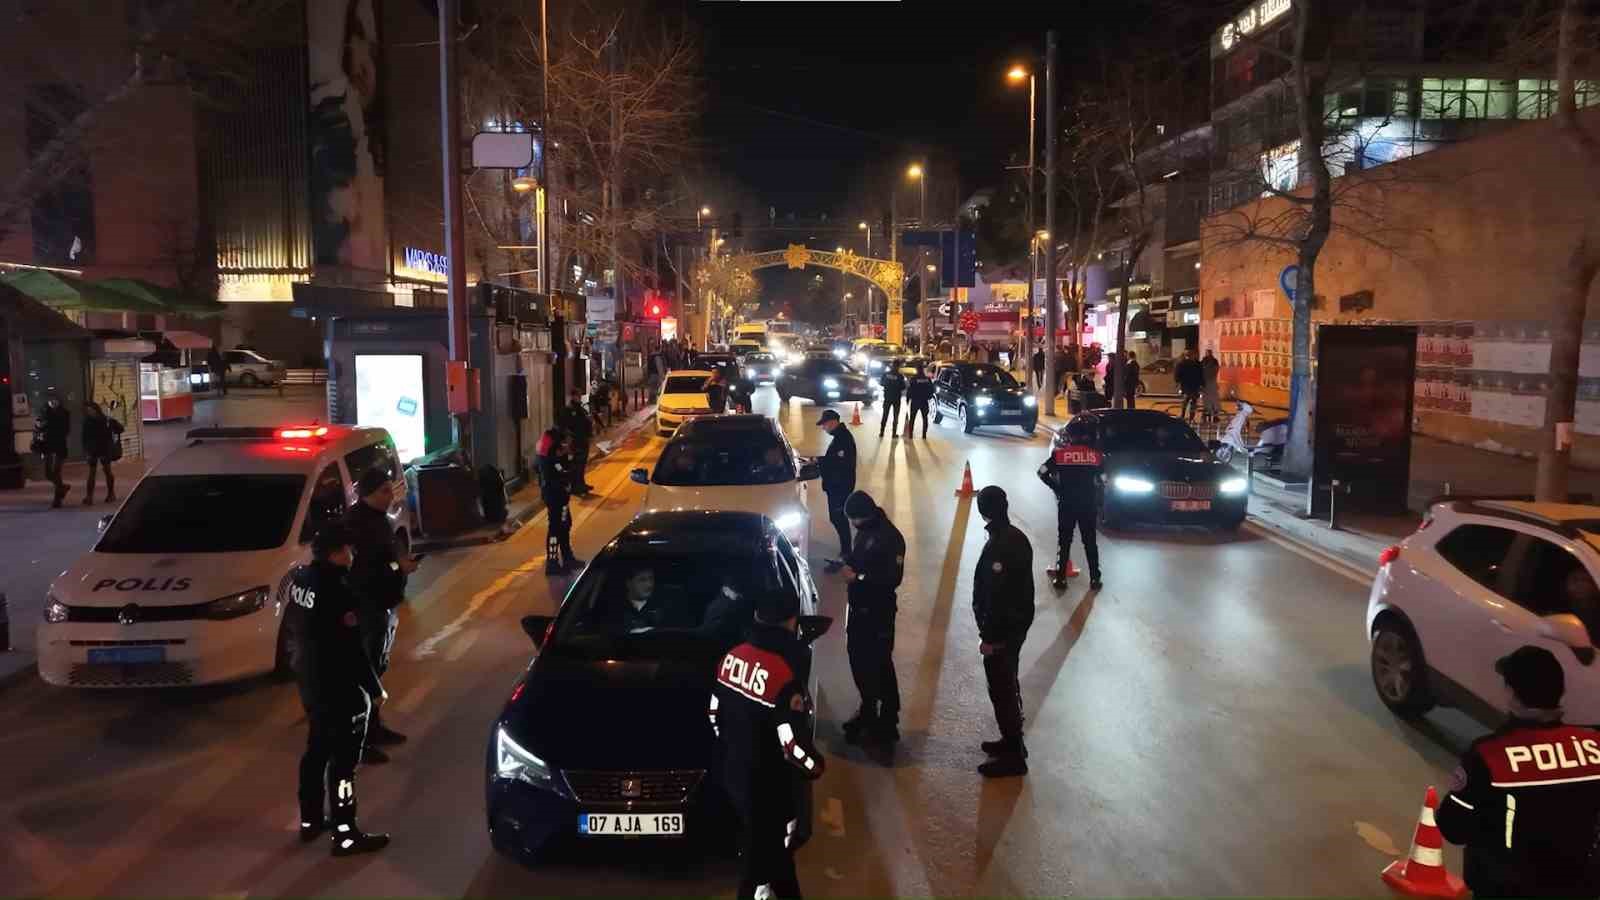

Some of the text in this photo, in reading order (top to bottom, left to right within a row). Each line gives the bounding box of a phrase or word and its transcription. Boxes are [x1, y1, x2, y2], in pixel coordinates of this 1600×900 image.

[720, 653, 769, 696] POLİS
[1504, 735, 1600, 773] POLİS
[589, 815, 607, 832] 07
[614, 815, 642, 832] AJA
[653, 815, 681, 832] 169
